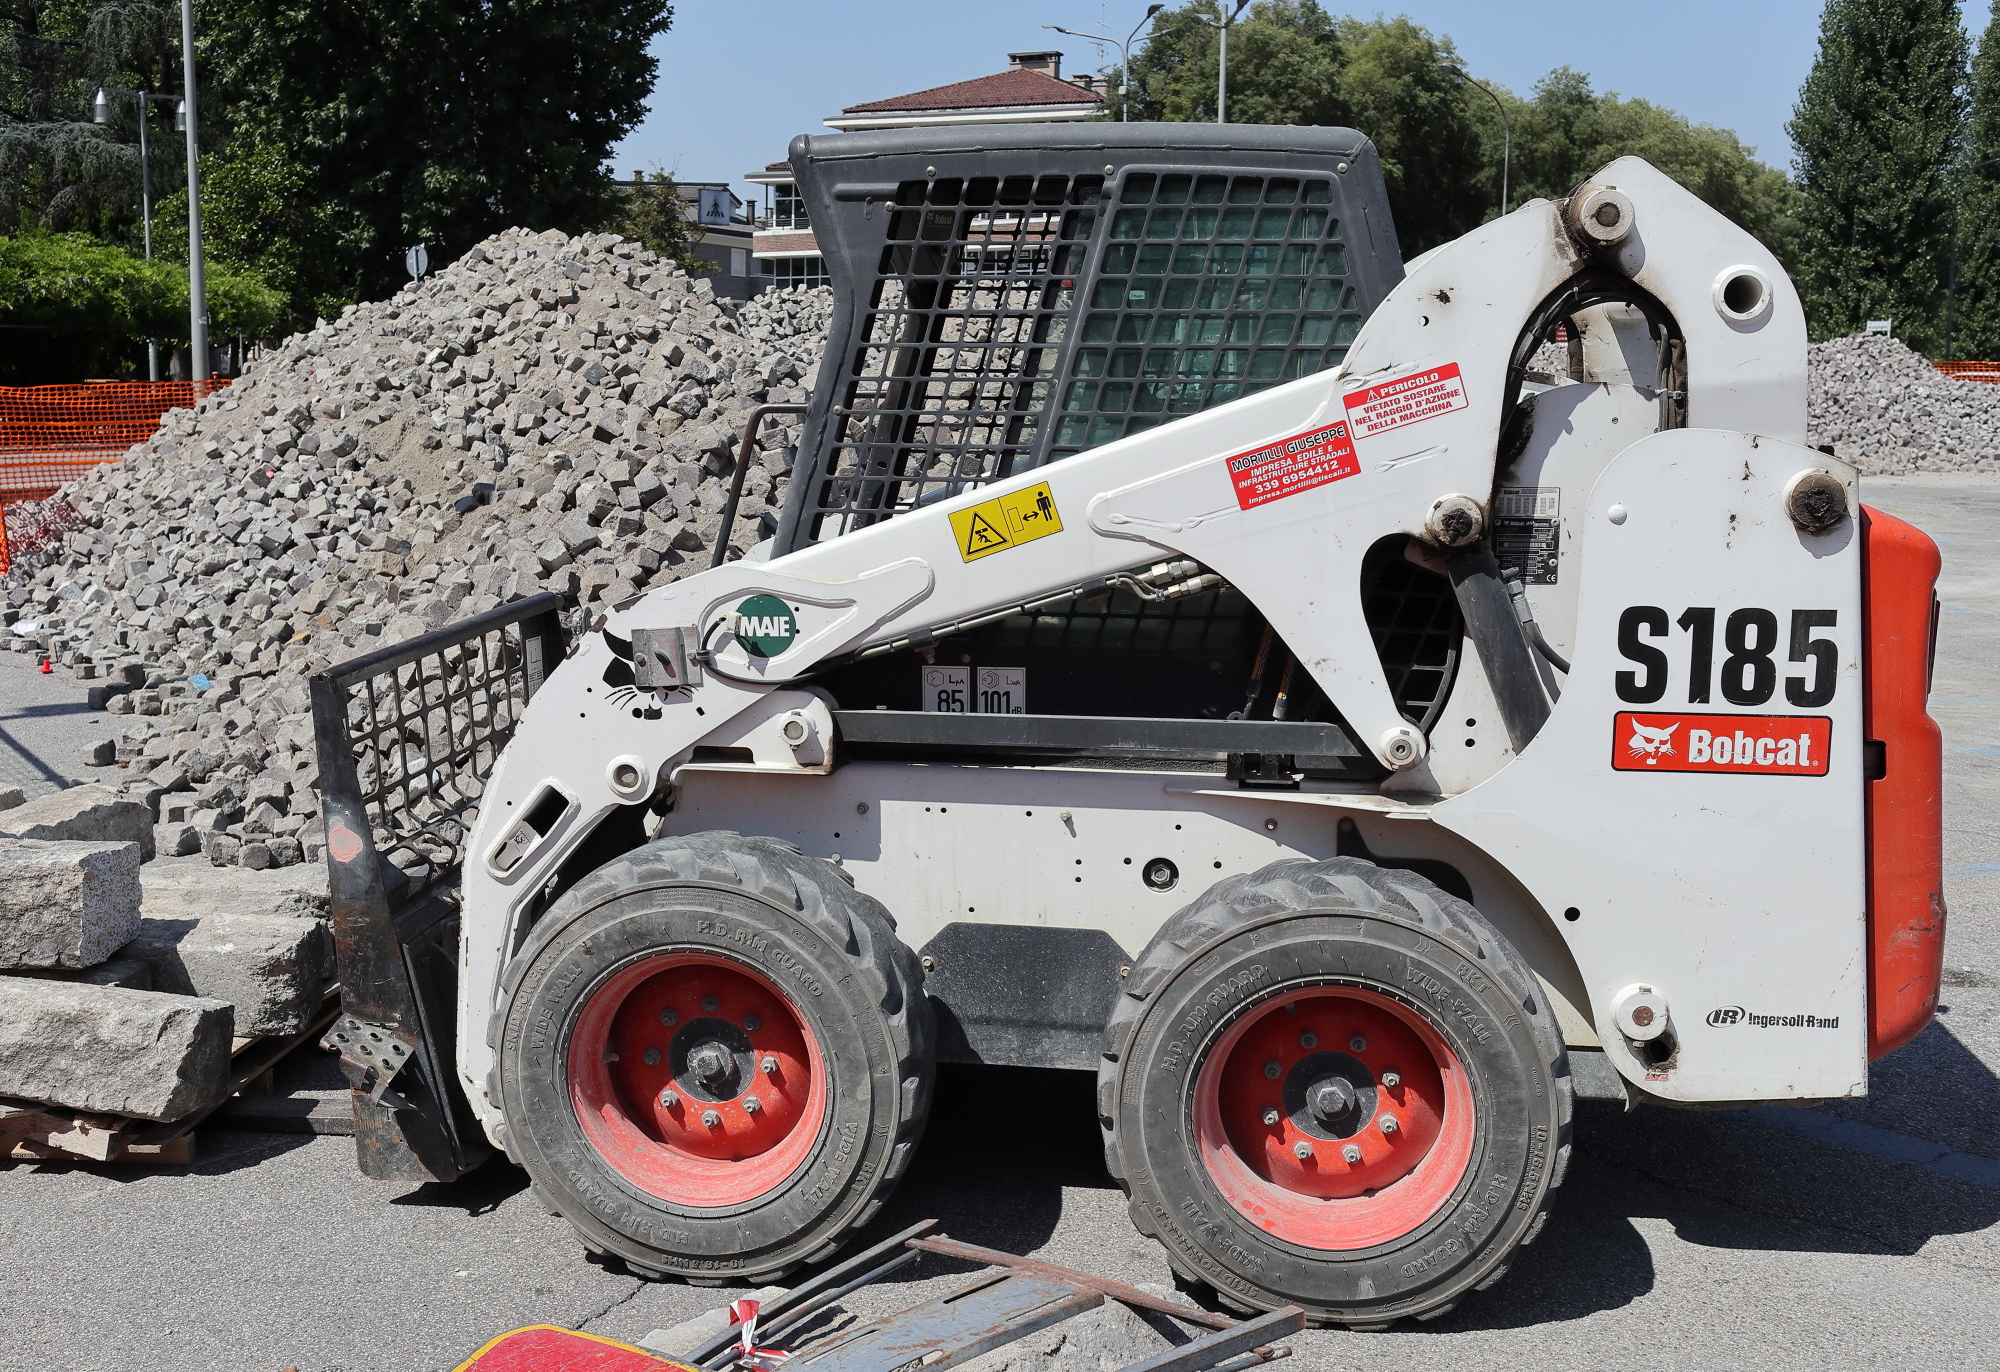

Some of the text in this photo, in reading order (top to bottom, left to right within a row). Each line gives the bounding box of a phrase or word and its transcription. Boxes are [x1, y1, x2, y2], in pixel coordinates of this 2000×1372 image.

[1363, 383, 1447, 414] VIETATO SOSTARE
[1380, 372, 1439, 397] PERICOLO
[1355, 389, 1460, 426] NEL RAGGIO D'AZIONE
[1367, 401, 1453, 432] DELLA MACCHINA
[1231, 425, 1346, 473] MORTILLI GIUSEPPE
[1251, 458, 1292, 477] IMPRESA
[1297, 447, 1323, 462] EDILE
[1239, 447, 1350, 489] INFRASTRUTTURE STRADALI
[1255, 460, 1339, 493] 339 6954412
[740, 616, 790, 637] MAIE
[1615, 606, 1838, 708] S185
[937, 689, 964, 712] 85
[980, 690, 1011, 713] 101
[1688, 729, 1812, 767] Bobcat
[733, 928, 770, 953] RIM
[768, 946, 825, 999] GUARD
[1453, 960, 1494, 996] BKT
[529, 960, 583, 1051] WIDE WALL
[1177, 1002, 1210, 1038] RIM
[1204, 960, 1267, 1007] GUARD
[1402, 965, 1495, 1046] WIDE WALL
[800, 1120, 861, 1208] WIDE WALL
[848, 1160, 876, 1195] BKT
[565, 1167, 619, 1218] GUARD
[617, 1211, 653, 1236] RIM
[1177, 1194, 1268, 1274] WIDE WALL
[1457, 1207, 1491, 1240] RIM
[1397, 1236, 1463, 1280] GUARD
